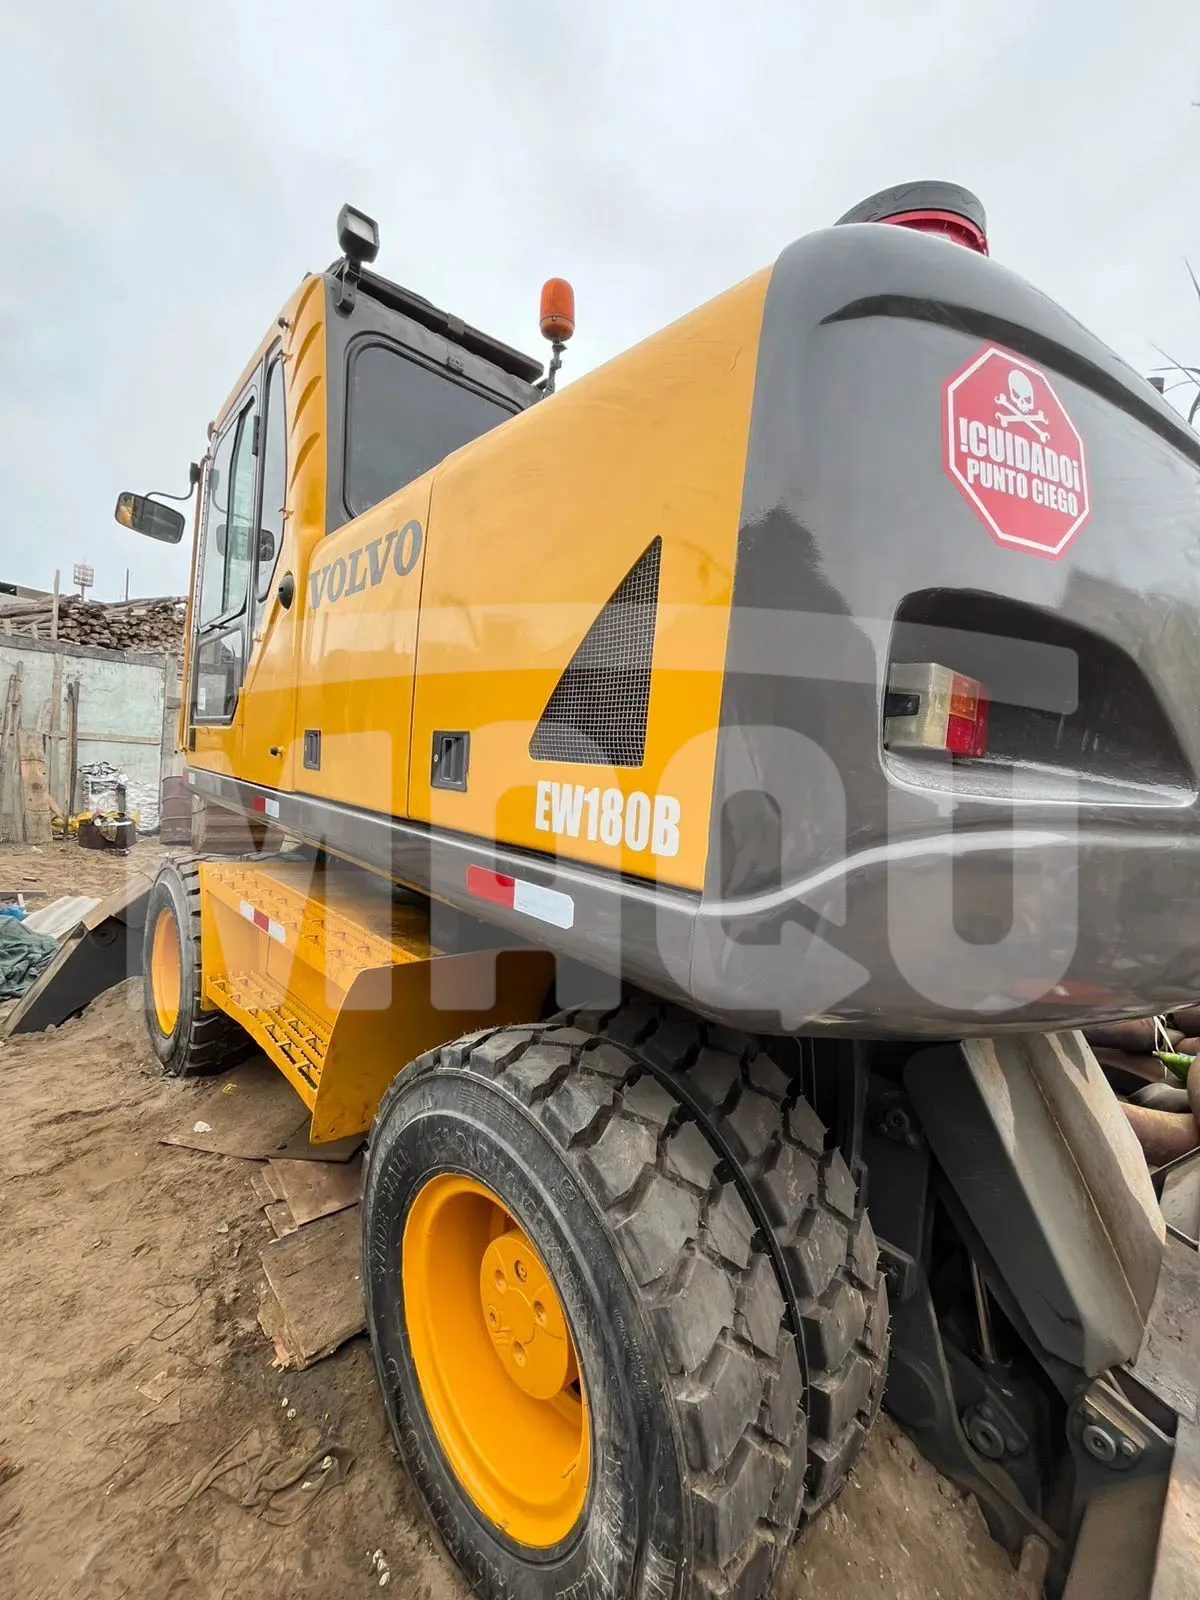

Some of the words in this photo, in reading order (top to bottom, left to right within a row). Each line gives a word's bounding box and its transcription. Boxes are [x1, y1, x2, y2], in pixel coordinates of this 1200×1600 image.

[967, 458, 1029, 499] PUNTO
[1033, 479, 1078, 516] CIEGO
[308, 519, 423, 609] VOLVO
[535, 780, 681, 857] EW180B
